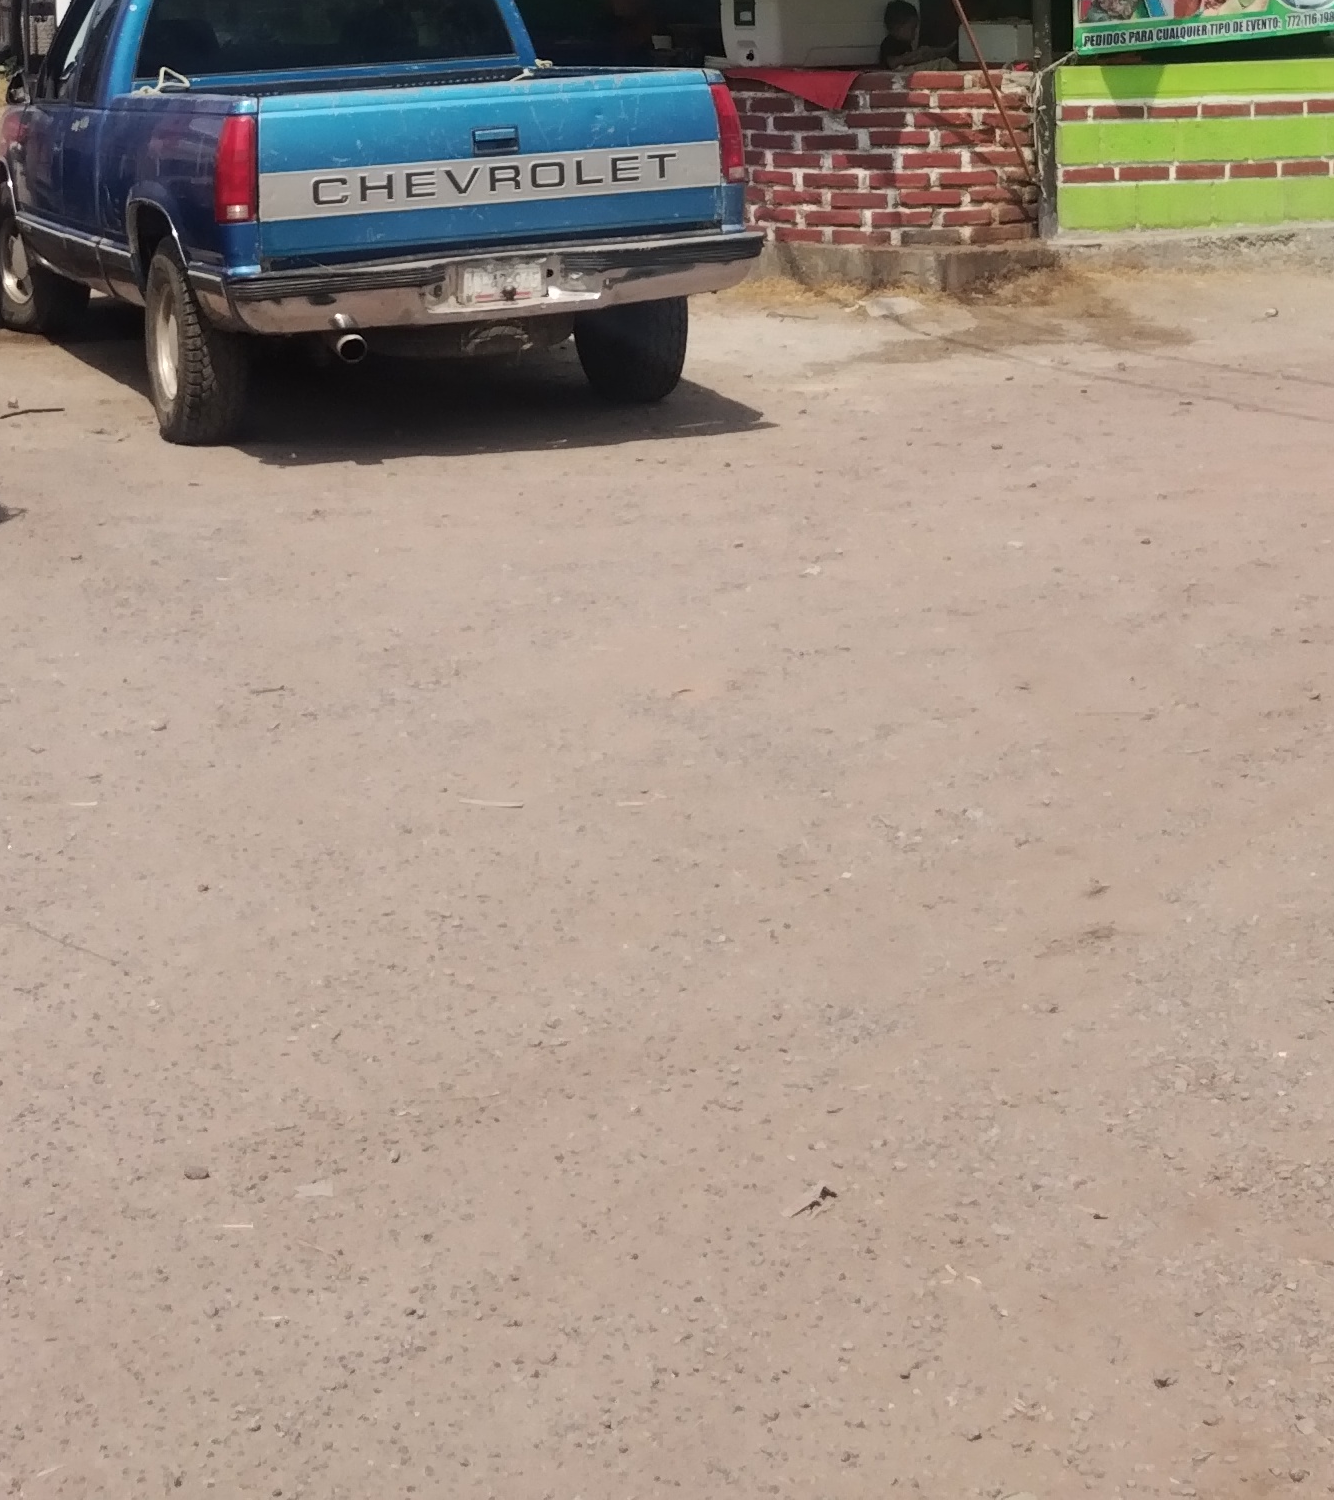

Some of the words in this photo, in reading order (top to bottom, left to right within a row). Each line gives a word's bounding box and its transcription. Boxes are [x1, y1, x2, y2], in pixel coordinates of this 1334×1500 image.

[1083, 32, 1126, 47] PEDIDOS
[1128, 29, 1154, 45] PARA
[1155, 24, 1208, 42] CUALQUIER
[1209, 21, 1231, 36] TIPO
[1232, 19, 1244, 33] DE
[311, 151, 678, 207] CHEVROLET
